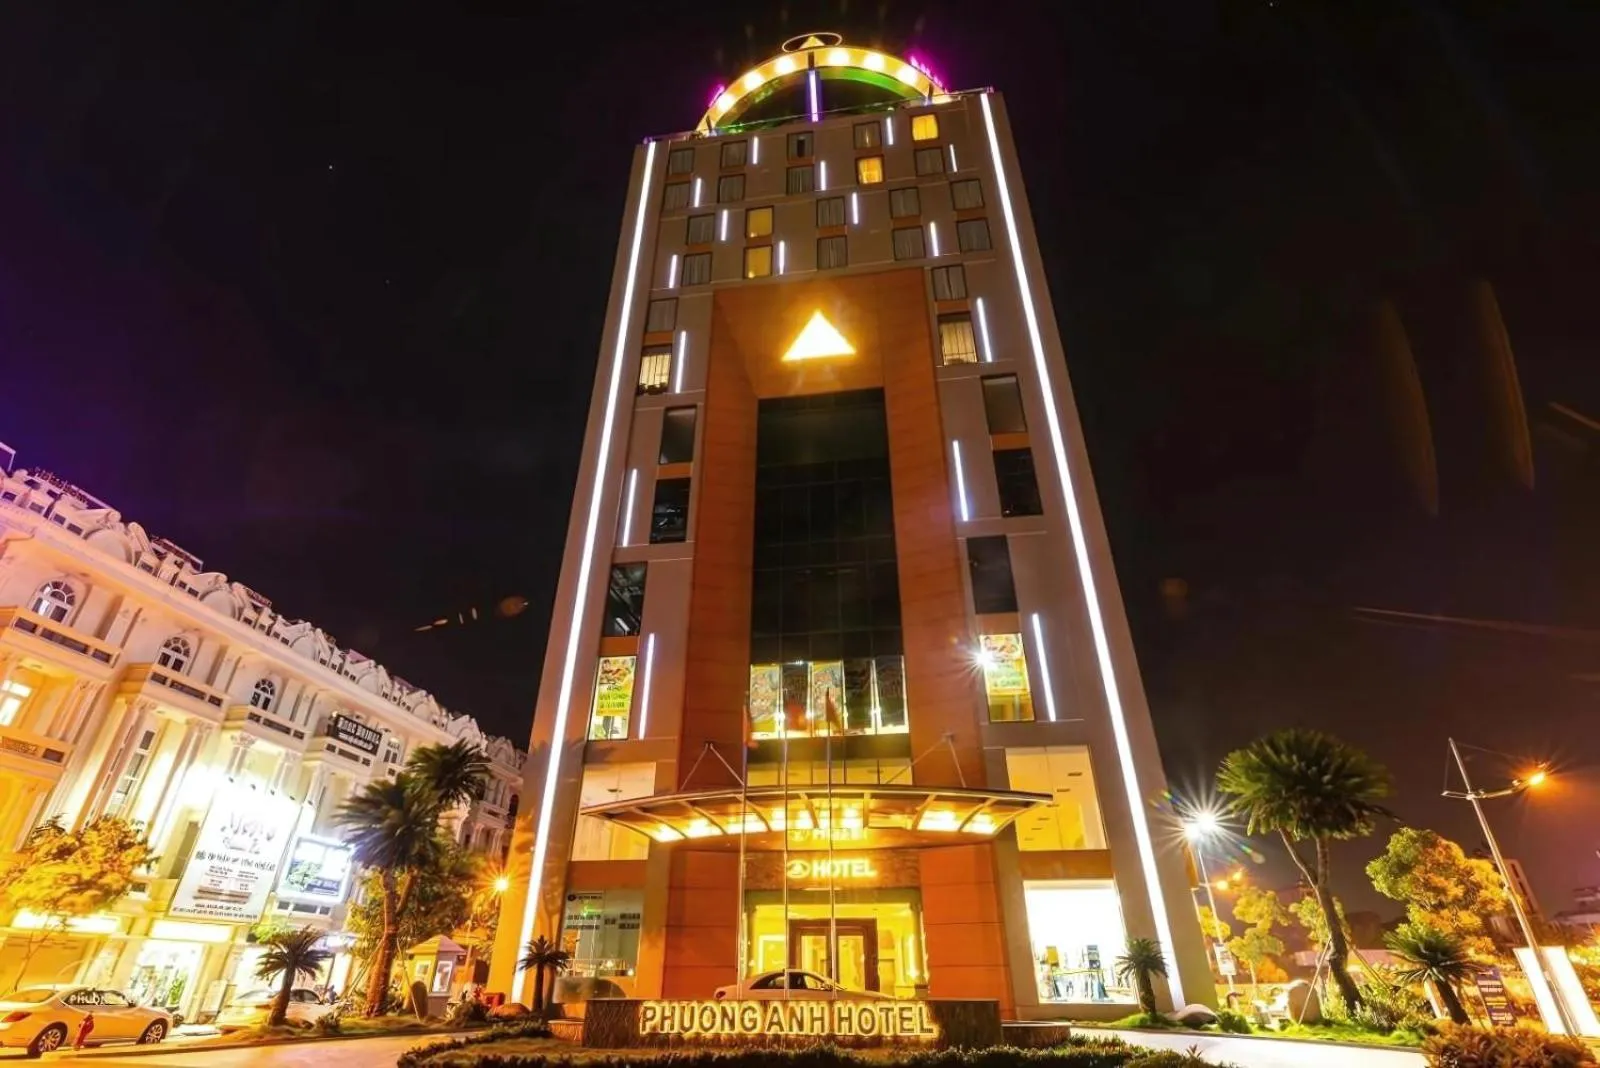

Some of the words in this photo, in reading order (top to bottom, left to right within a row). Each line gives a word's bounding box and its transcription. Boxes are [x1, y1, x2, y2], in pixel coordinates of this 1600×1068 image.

[812, 858, 877, 879] HOTEL
[765, 1002, 828, 1034] ANH
[834, 1003, 938, 1037] HOTEL
